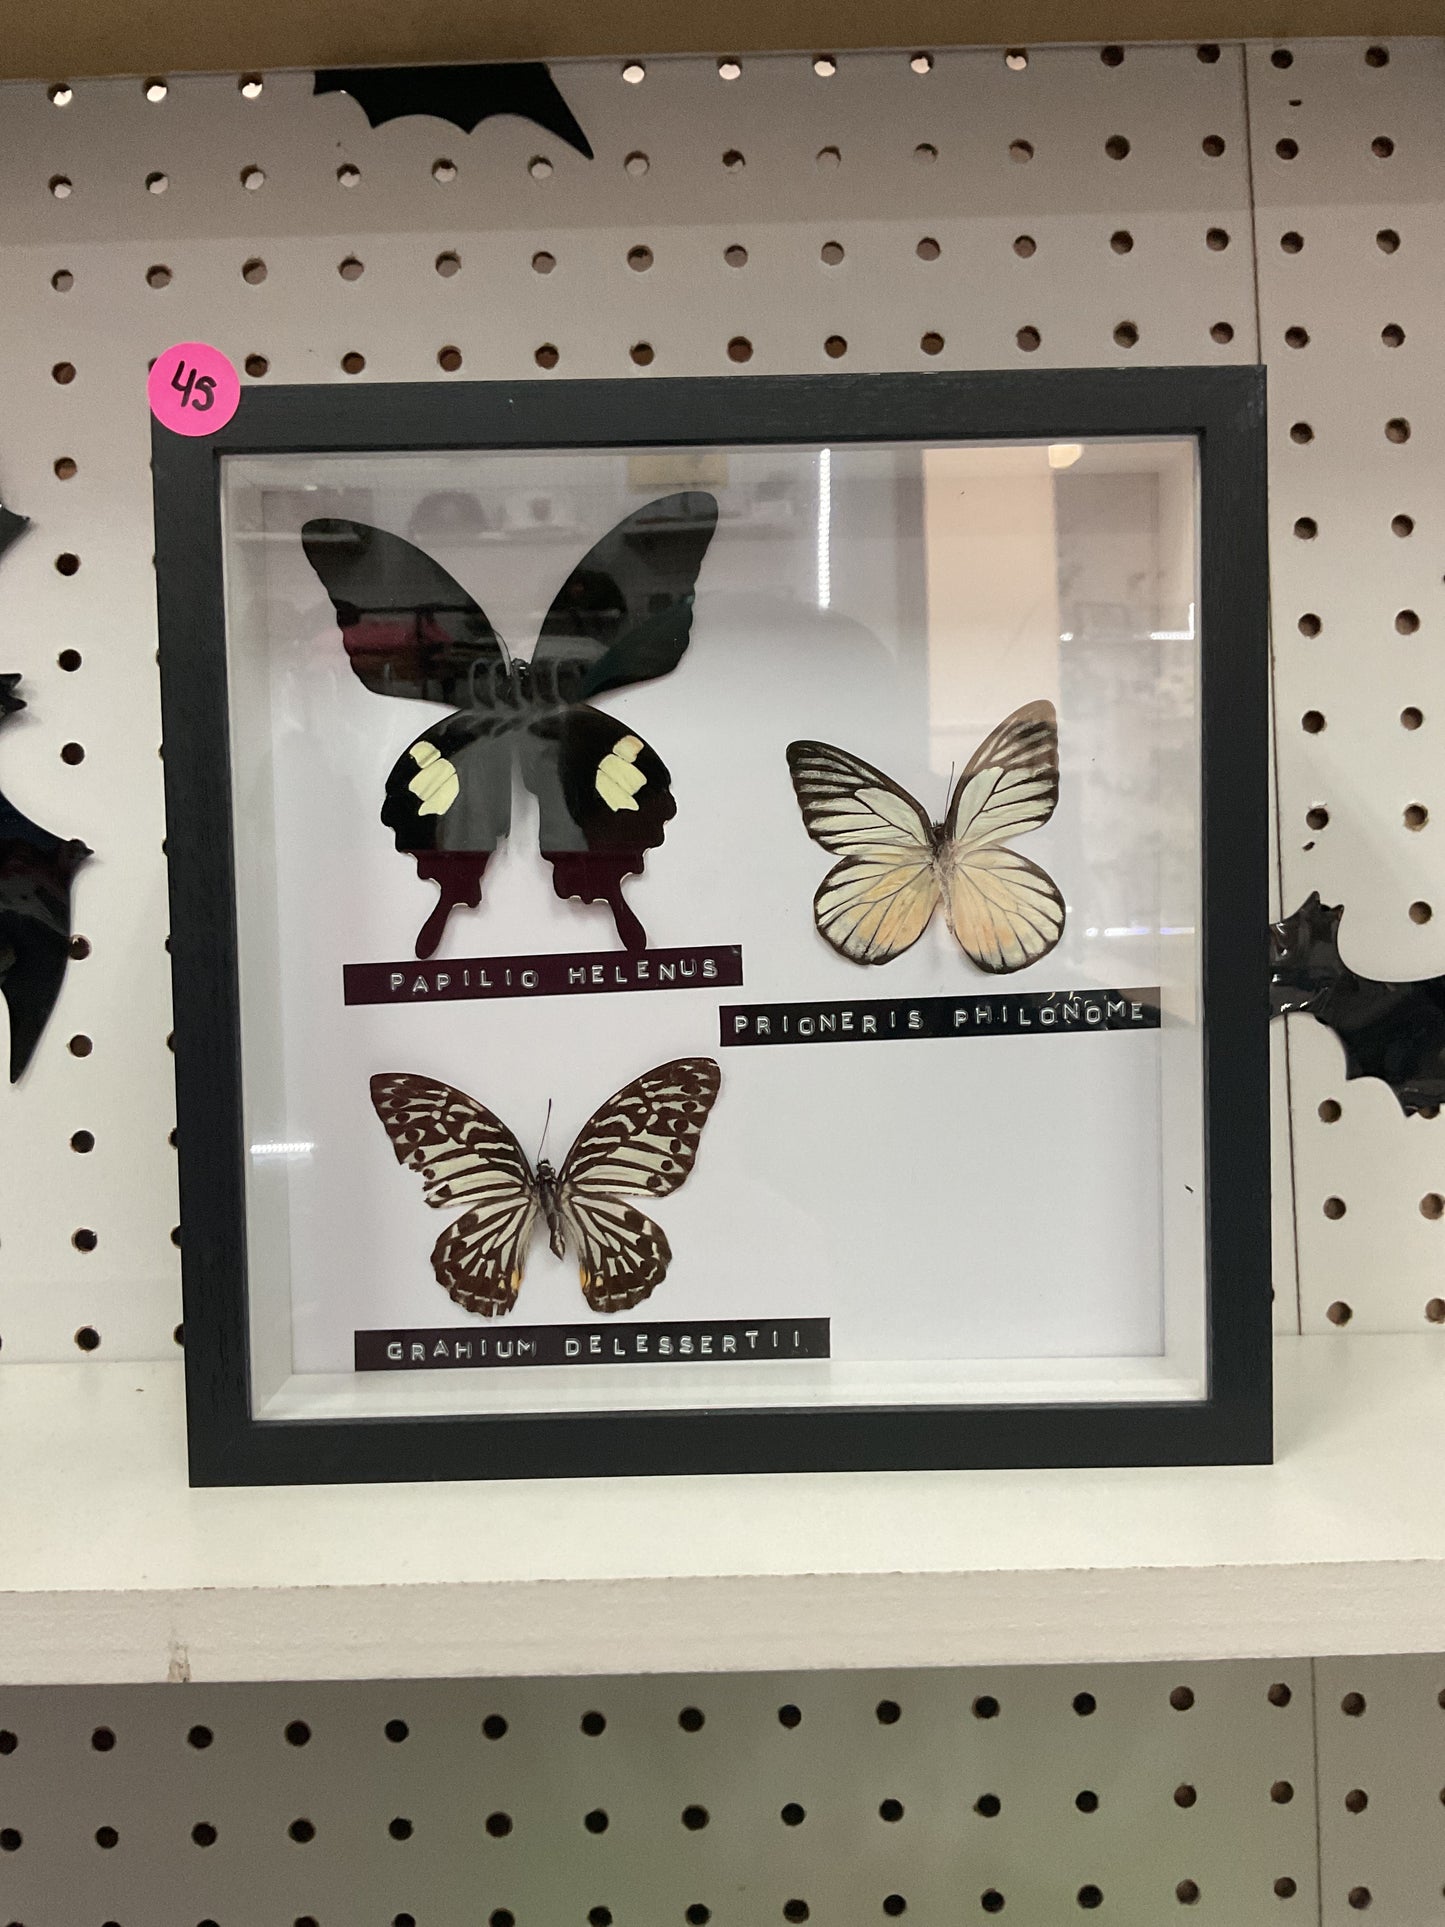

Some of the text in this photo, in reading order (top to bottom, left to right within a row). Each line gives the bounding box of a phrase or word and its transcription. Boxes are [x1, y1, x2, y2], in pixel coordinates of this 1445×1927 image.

[390, 958, 719, 994] PAPILIO HELENUS
[734, 1000, 1145, 1036] PRIONERIS PHILONOME
[386, 1330, 802, 1361] GRAHIUM DELESSERTII
